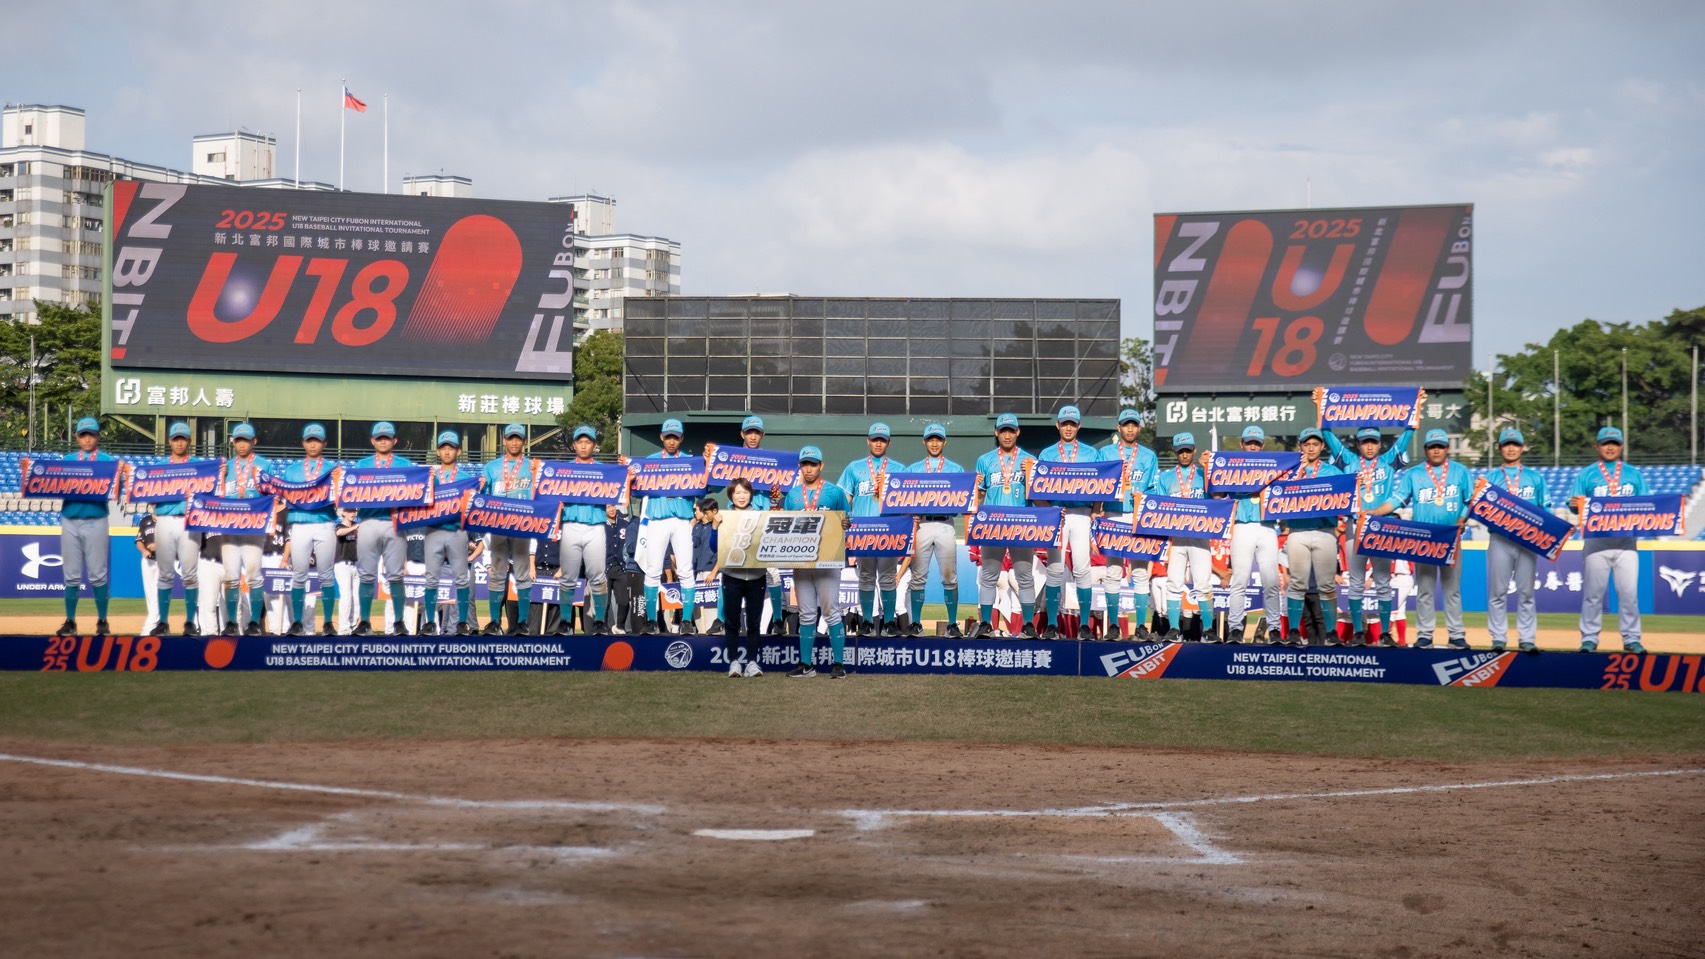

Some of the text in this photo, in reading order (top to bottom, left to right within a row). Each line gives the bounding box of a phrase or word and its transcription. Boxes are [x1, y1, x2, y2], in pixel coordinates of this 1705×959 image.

[216, 209, 288, 231] 2025
[370, 218, 422, 227] INTERNATIONAL
[1289, 218, 1363, 240] 2025
[338, 225, 383, 233] INVITATIONAL
[384, 227, 430, 235] TOURNAMENT
[1271, 243, 1357, 312] U
[1417, 217, 1471, 343] FUBON
[186, 252, 410, 346] U18
[1246, 316, 1325, 378] 18
[147, 386, 234, 408] 富邦人壽
[458, 394, 565, 415] 新莊棒球場
[1192, 406, 1296, 423] 台北富邦銀行
[1325, 404, 1411, 421] CHAMPIONS
[711, 463, 796, 487] CHAMPIONS
[29, 477, 111, 495] CHAMPIONS
[133, 475, 216, 498] CHAMPIONS
[342, 483, 425, 503] CHAMPIONS
[538, 479, 621, 498] CHAMPIONS
[1033, 476, 1117, 495] CHAMPIONS
[886, 490, 969, 507] CHAMPIONS
[1268, 492, 1352, 514] CHAMPIONS
[189, 509, 268, 529] CHAMPIONS
[468, 509, 551, 534] CHAMPIONS
[765, 516, 822, 535] 冠軍
[1140, 512, 1226, 534] CHAMPIONS
[1474, 501, 1557, 550] CHAMPIONS
[1587, 513, 1676, 532] CHAMPIONS
[273, 535, 284, 546] 34
[763, 536, 818, 544] CHAMPION
[845, 532, 908, 551] AMPIONS
[971, 523, 1056, 542] CHAMPIONS
[760, 545, 816, 553] NT. 80000
[1363, 533, 1450, 559] CHAMPIONS
[45, 637, 76, 654] 20
[76, 636, 161, 672] U18
[272, 644, 565, 654] NEW TAIPEI CITY FUBON INTITY FUBON INTERNATIONAL
[41, 656, 68, 672] 25
[266, 657, 284, 666] U18
[286, 657, 340, 666] BASEBALL
[341, 657, 416, 666] INVITATIONAL
[494, 657, 571, 666] TOURNAMENT
[1100, 643, 1164, 678] FUBON
[1128, 653, 1166, 679] NBIT
[1233, 653, 1379, 665] NEW TAIPEI CERNATIONAL
[1604, 654, 1639, 673] 20
[1227, 665, 1386, 678] U18 BASEBALL TOURNAMENT
[1462, 661, 1501, 687] NBIT
[1639, 654, 1705, 692] U1
[1602, 673, 1632, 690] 25
